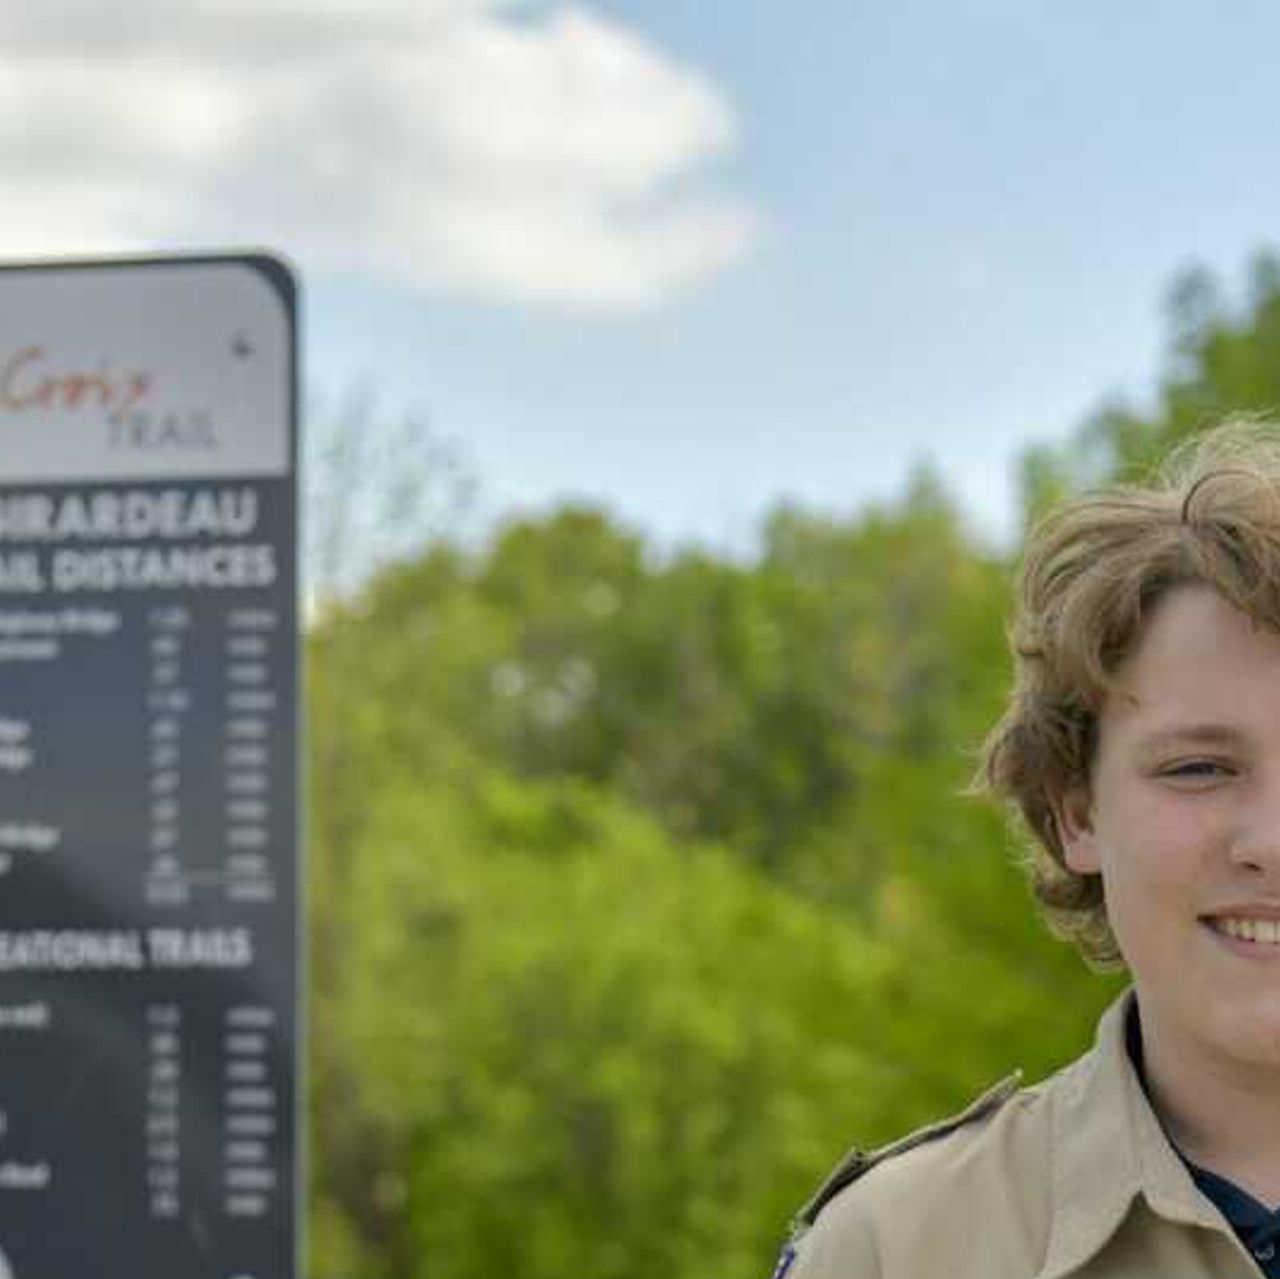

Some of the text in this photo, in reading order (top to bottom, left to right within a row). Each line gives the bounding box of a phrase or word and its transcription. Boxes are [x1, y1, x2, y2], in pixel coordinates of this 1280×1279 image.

[107, 409, 221, 450] TRAIL
[52, 544, 276, 593] DISTANCES
[148, 924, 252, 968] TRAILS
